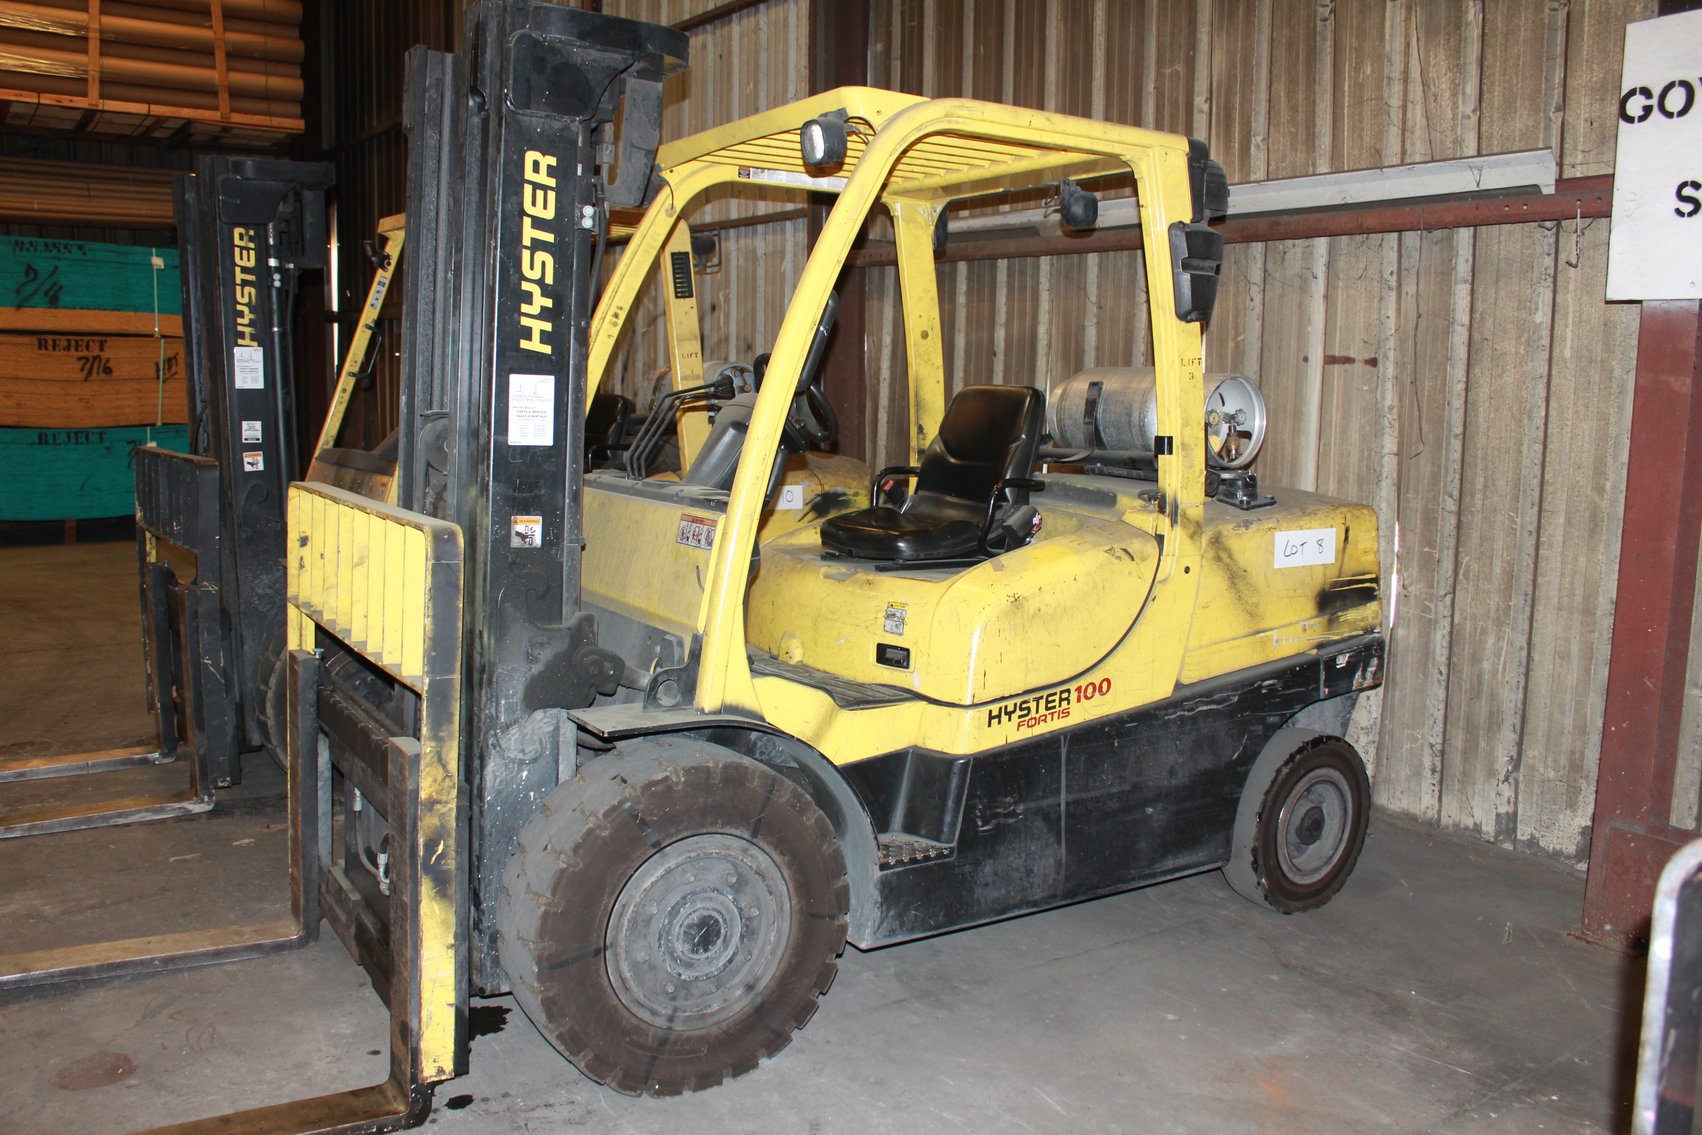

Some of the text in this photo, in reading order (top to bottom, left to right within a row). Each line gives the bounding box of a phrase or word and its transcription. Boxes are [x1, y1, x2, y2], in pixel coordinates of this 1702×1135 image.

[1619, 77, 1702, 124] GO
[519, 149, 557, 355] HYSTER
[233, 227, 258, 347] HYSTER
[37, 338, 108, 352] REJECT
[77, 354, 113, 382] 7/16
[1180, 357, 1202, 367] LIFT
[37, 431, 108, 446] REJECT
[1283, 538, 1325, 557] LOT 8
[987, 677, 1112, 728] HYSTER 100
[1017, 707, 1071, 732] FORTIS
